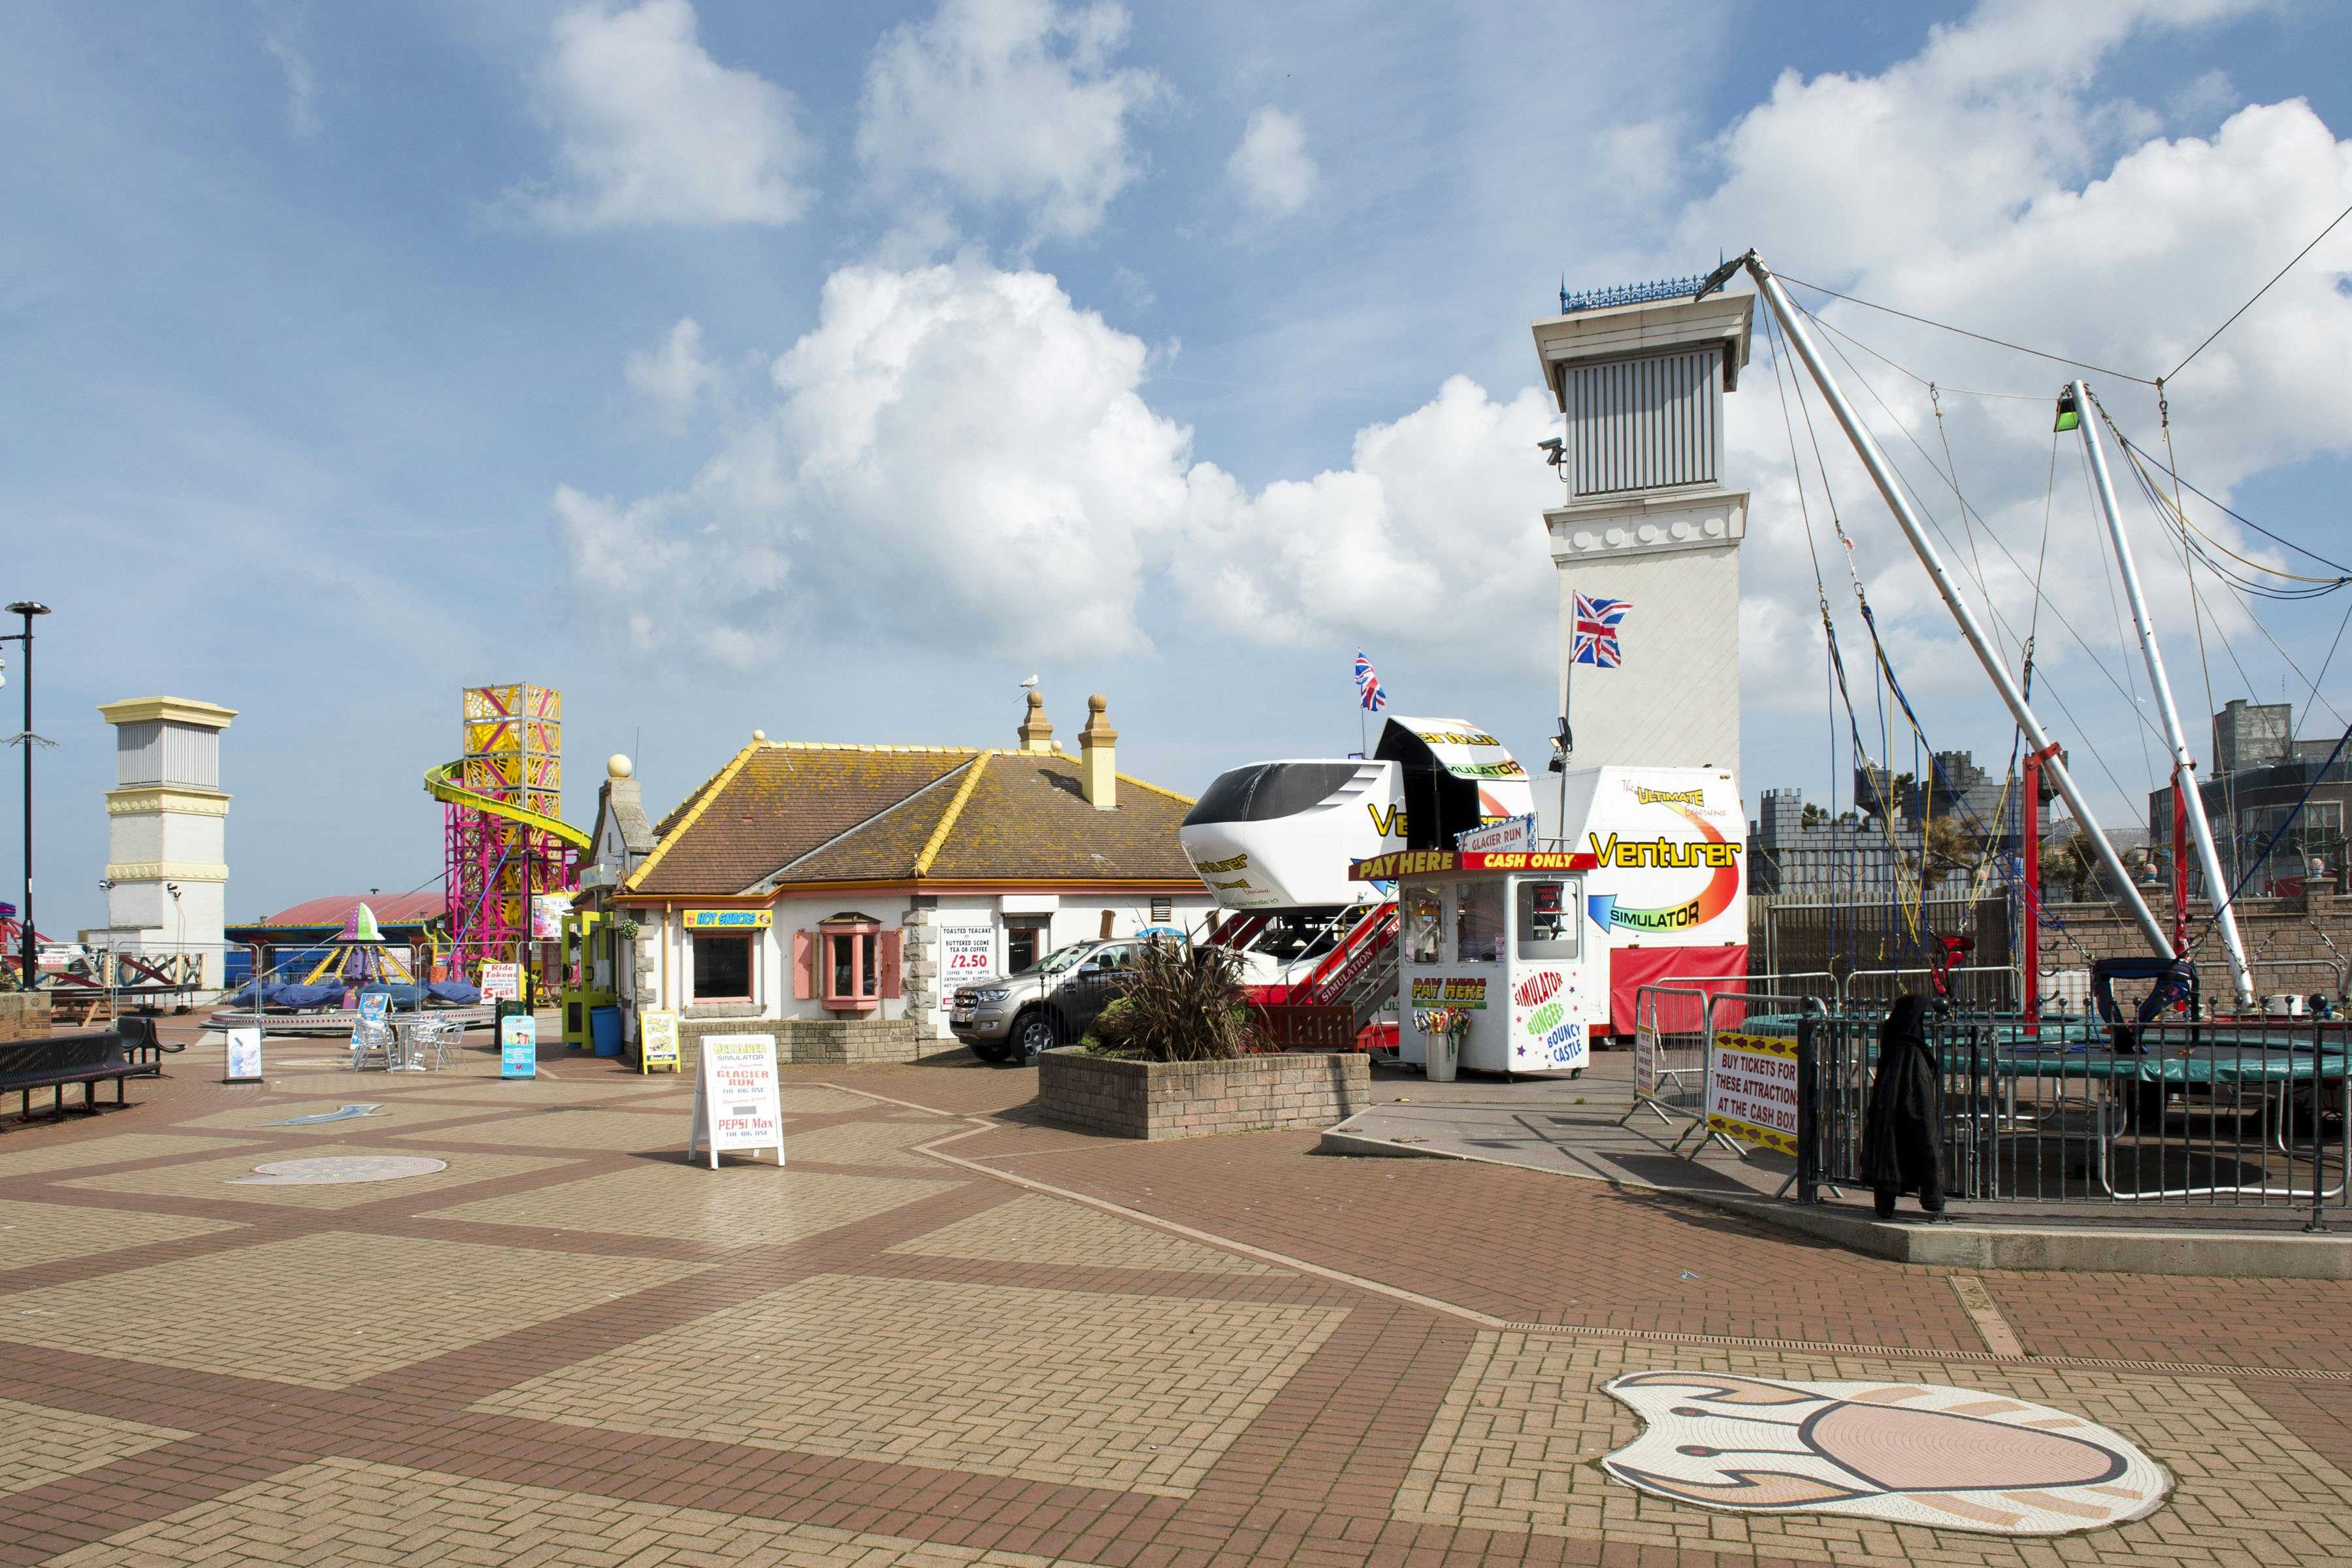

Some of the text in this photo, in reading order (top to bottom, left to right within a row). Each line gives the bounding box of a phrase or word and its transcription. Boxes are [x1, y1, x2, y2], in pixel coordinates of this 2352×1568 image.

[1622, 780, 1634, 792] The
[1637, 787, 1704, 807] ULTIMATE
[1685, 804, 1727, 820] Experience
[1472, 833, 1501, 851] GLACIER
[1504, 827, 1521, 843] RUN
[1590, 832, 1742, 868] Venturer
[1359, 852, 1454, 878] PAY HERE
[1484, 854, 1574, 868] CASH ONLY
[696, 912, 757, 925] HOT SNACKS
[1610, 901, 1699, 927] SIMULATOR
[951, 955, 987, 968] £2.50
[1322, 948, 1373, 1002] SIMULATION
[483, 987, 493, 999] 5
[495, 988, 514, 998] FREE
[1412, 977, 1486, 1000] PAY HERE
[1514, 972, 1563, 1007] SIMULATOR
[1527, 1003, 1563, 1035] BUNGEES
[1547, 1024, 1580, 1048] BOUNCY
[1554, 1039, 1582, 1062] CASTLE
[1722, 1053, 1796, 1081] BUY TICKETS FOR
[1716, 1073, 1797, 1106] THESE ATTRACTION
[719, 1118, 773, 1130] PEPSI Max
[1718, 1096, 1796, 1131] AT THE CASH BOX
